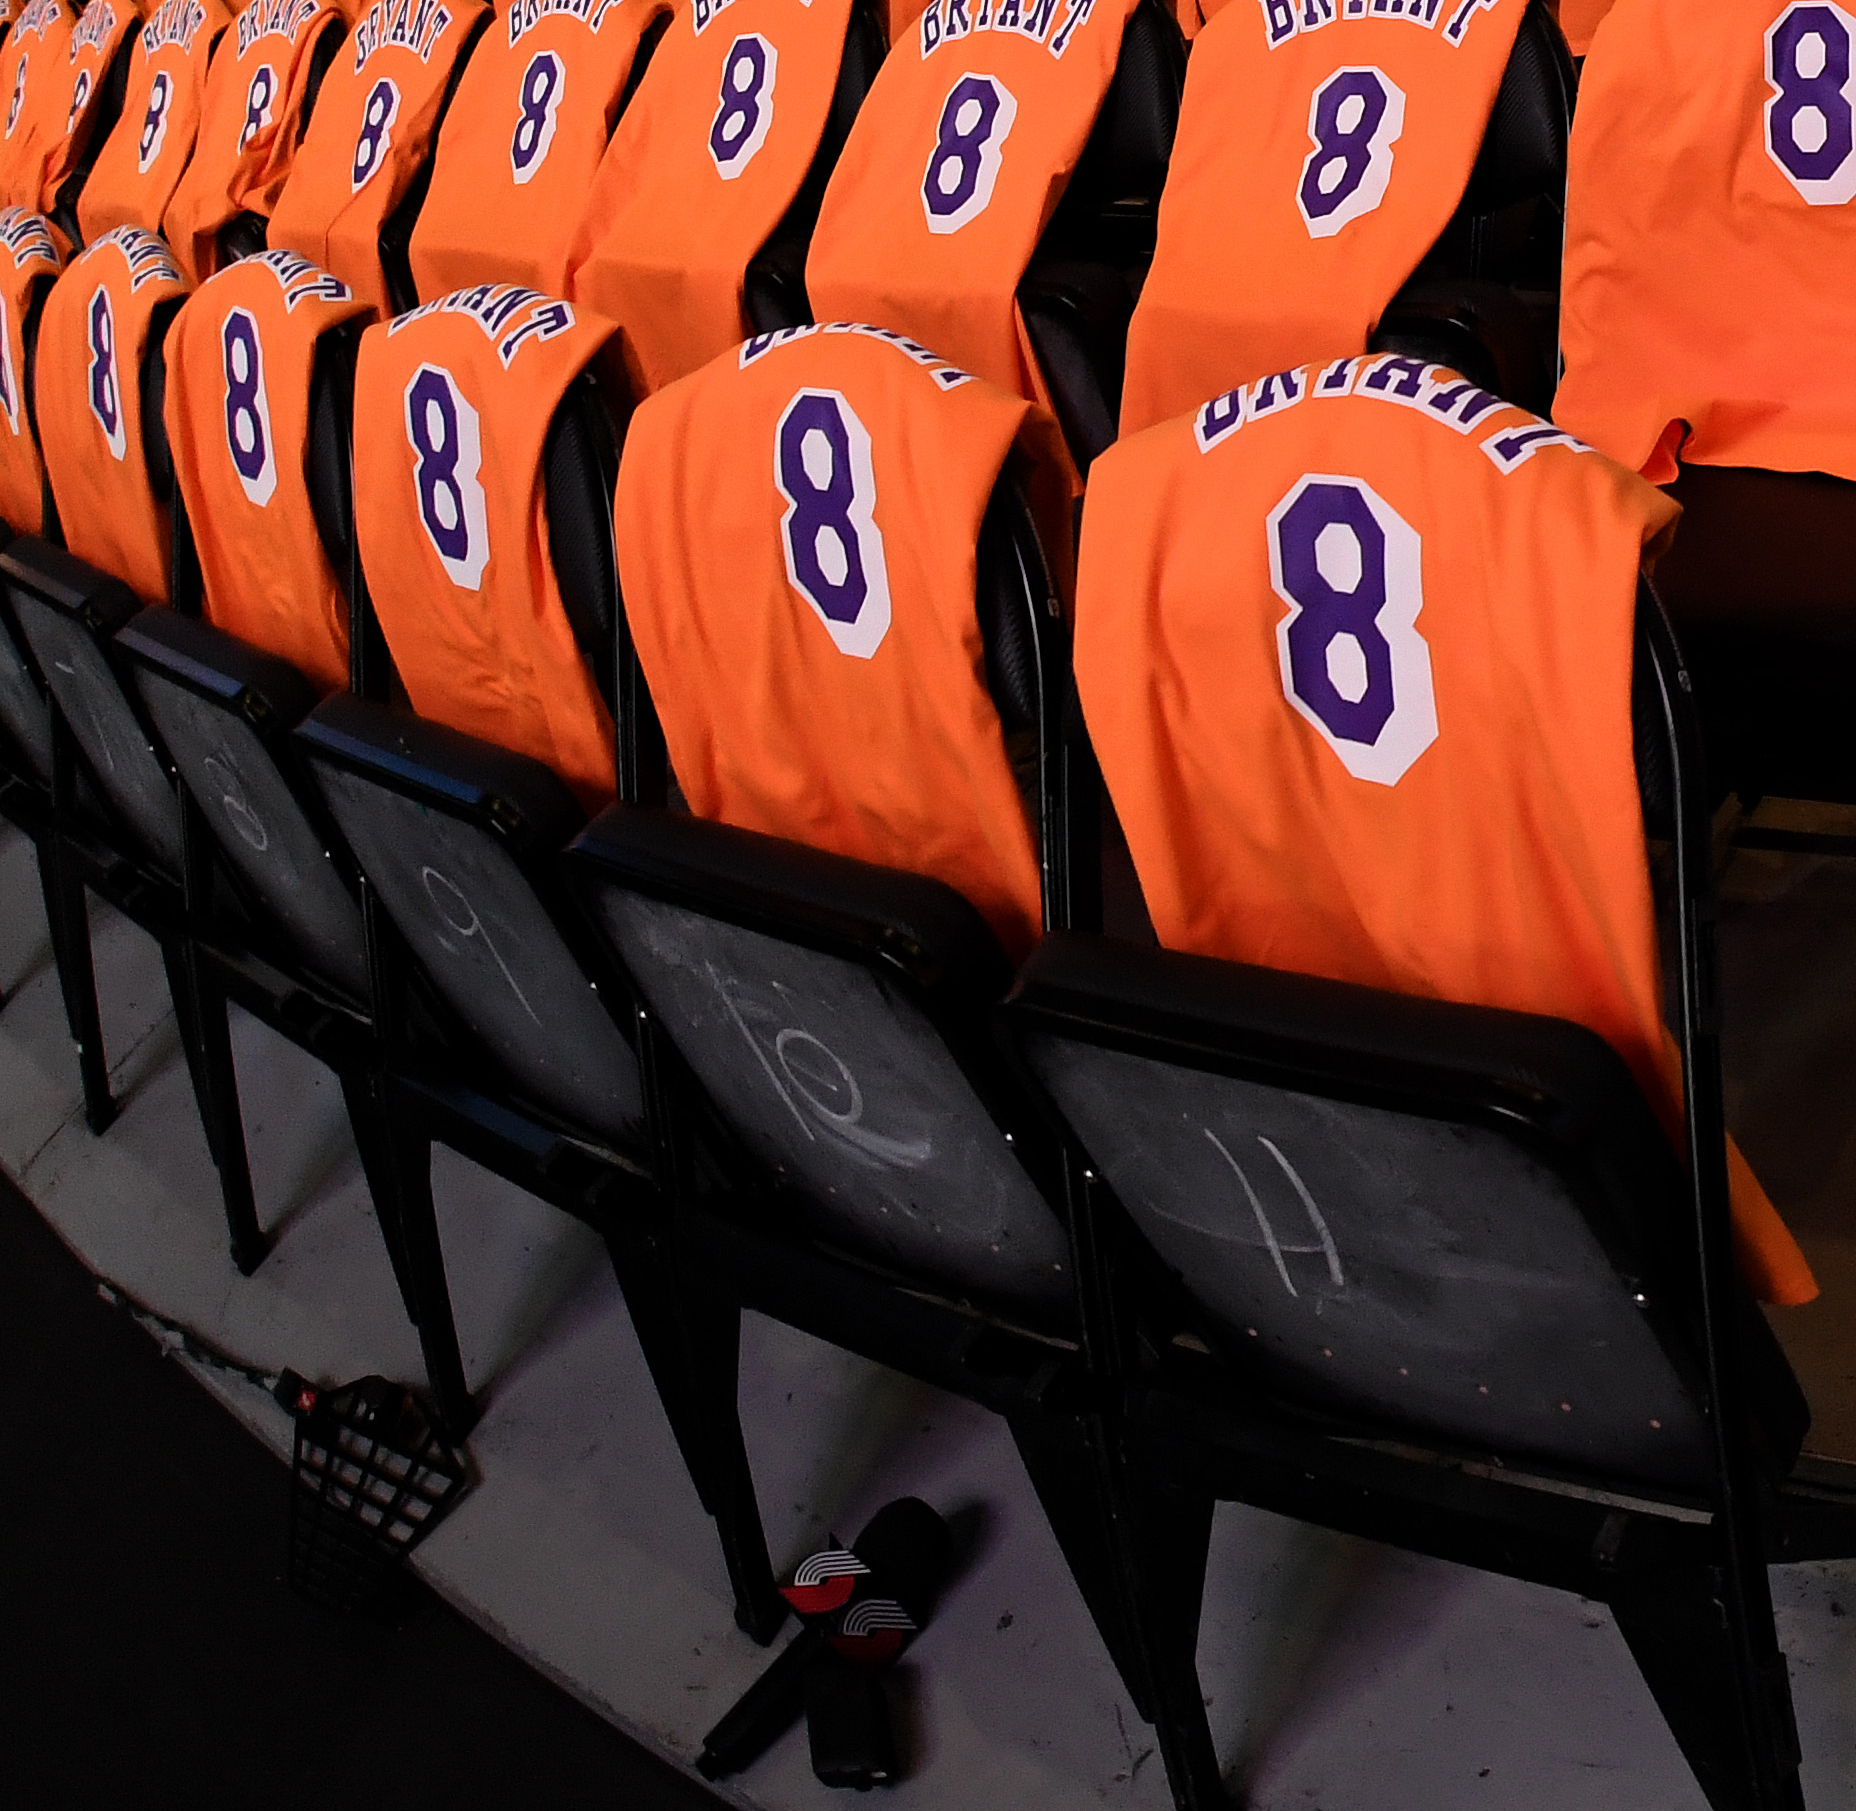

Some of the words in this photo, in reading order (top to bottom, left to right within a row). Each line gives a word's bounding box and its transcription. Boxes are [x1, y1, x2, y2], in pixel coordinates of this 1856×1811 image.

[139, 71, 173, 173] 8
[352, 77, 400, 192] 8
[510, 50, 566, 184] 8
[709, 33, 777, 180] 8
[921, 72, 1017, 234] 8
[1296, 66, 1405, 238] 8
[88, 284, 126, 461] 8
[224, 307, 277, 505] 8
[405, 363, 490, 590] 8
[774, 388, 891, 659] 8
[1266, 473, 1440, 787] 8
